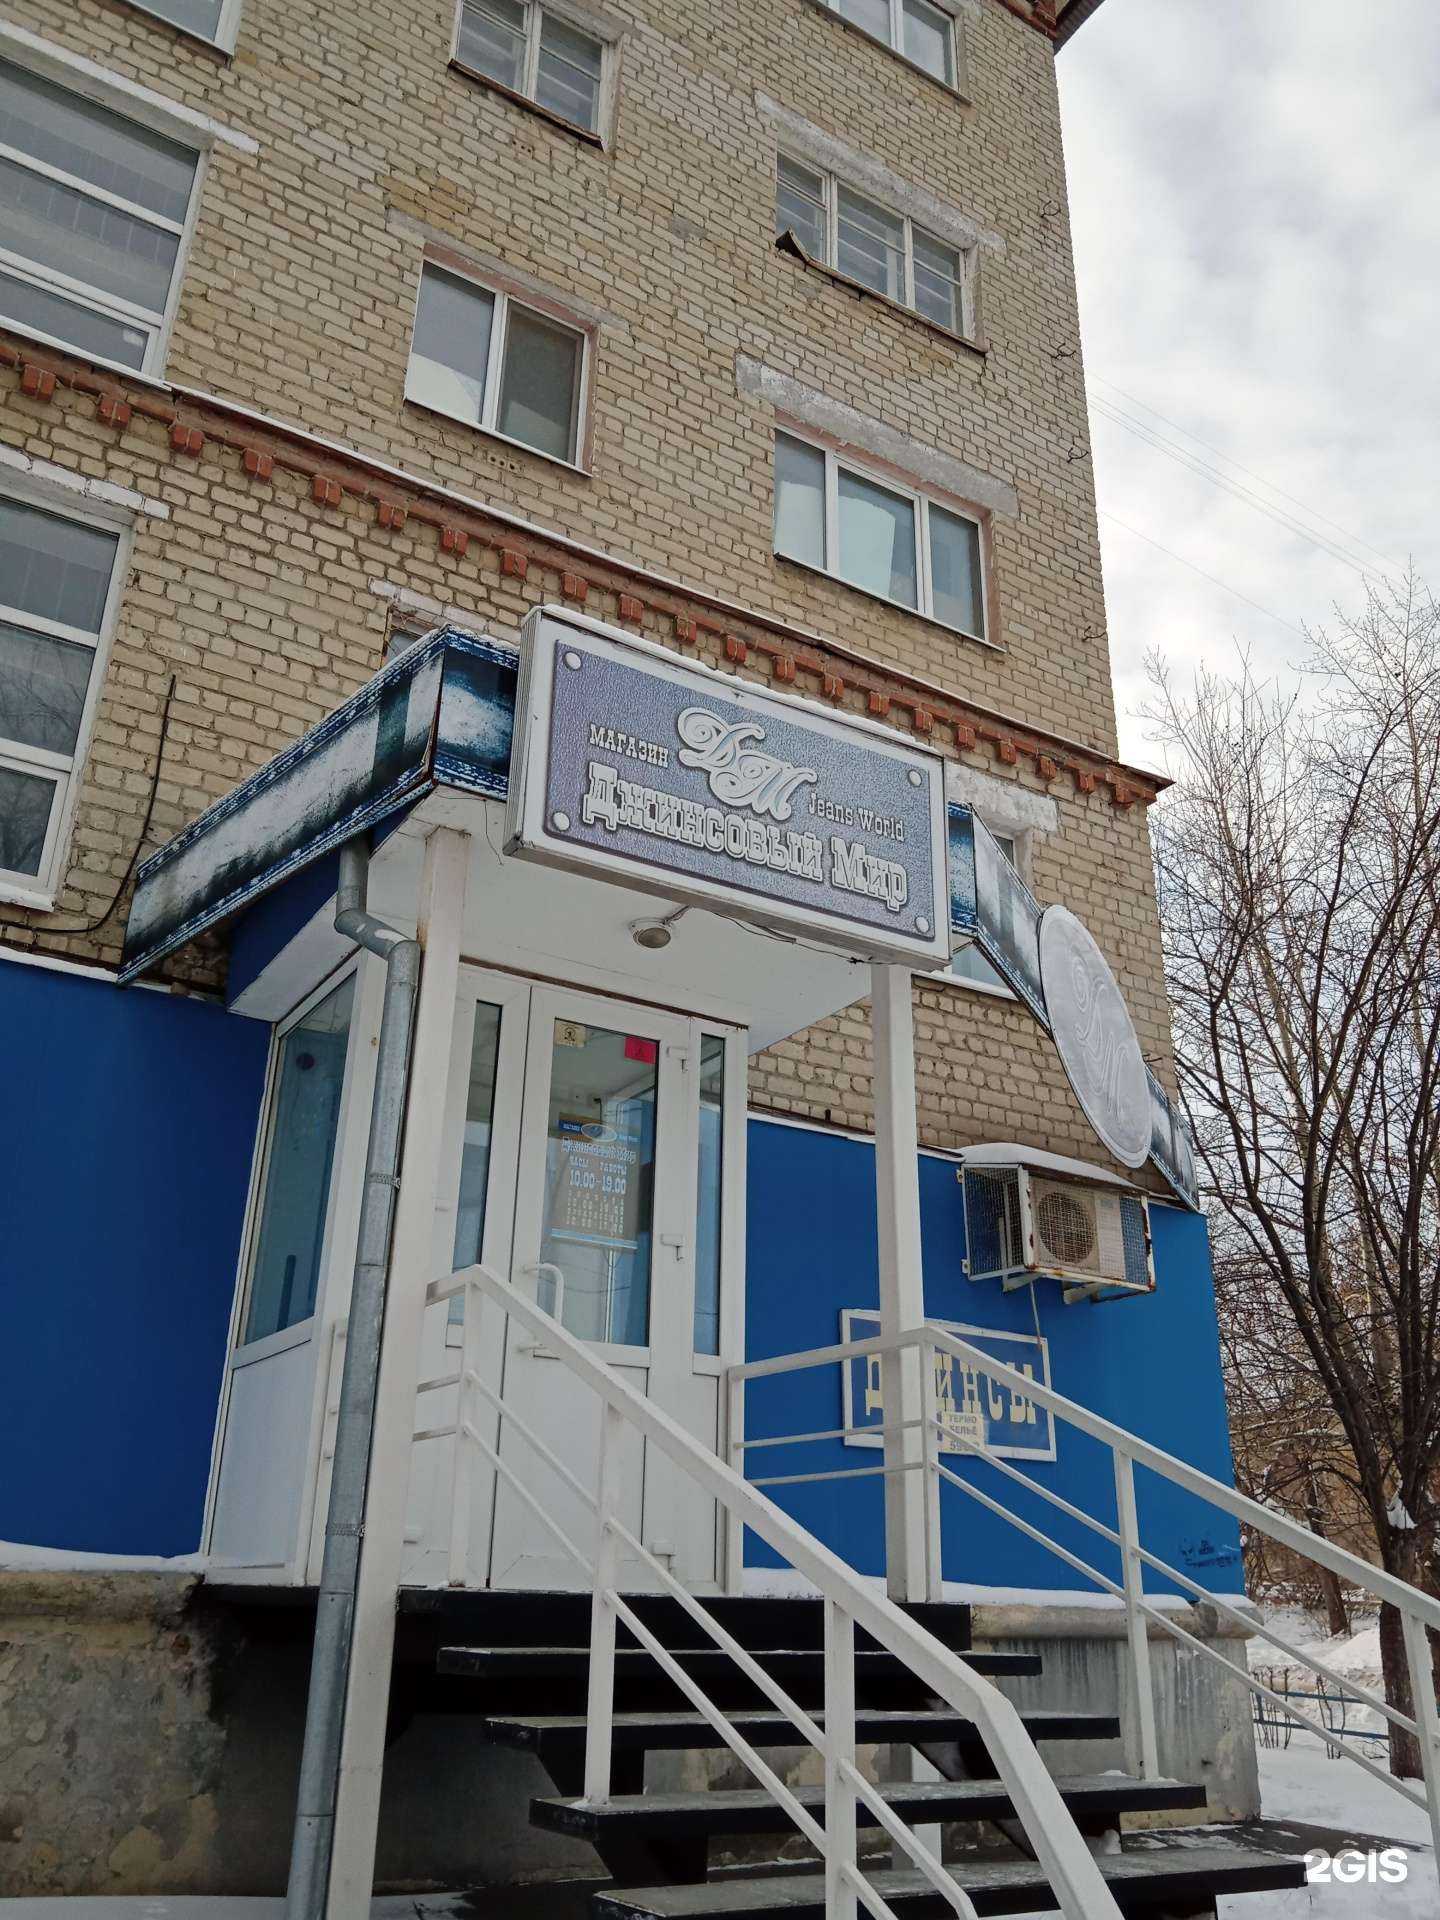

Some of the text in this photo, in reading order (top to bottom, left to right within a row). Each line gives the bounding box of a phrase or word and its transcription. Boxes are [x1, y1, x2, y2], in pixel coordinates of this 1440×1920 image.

[589, 723, 669, 768] МАГАЗИН
[808, 791, 905, 842] Jeans World
[865, 1352, 1036, 1425] ДИНСЫ
